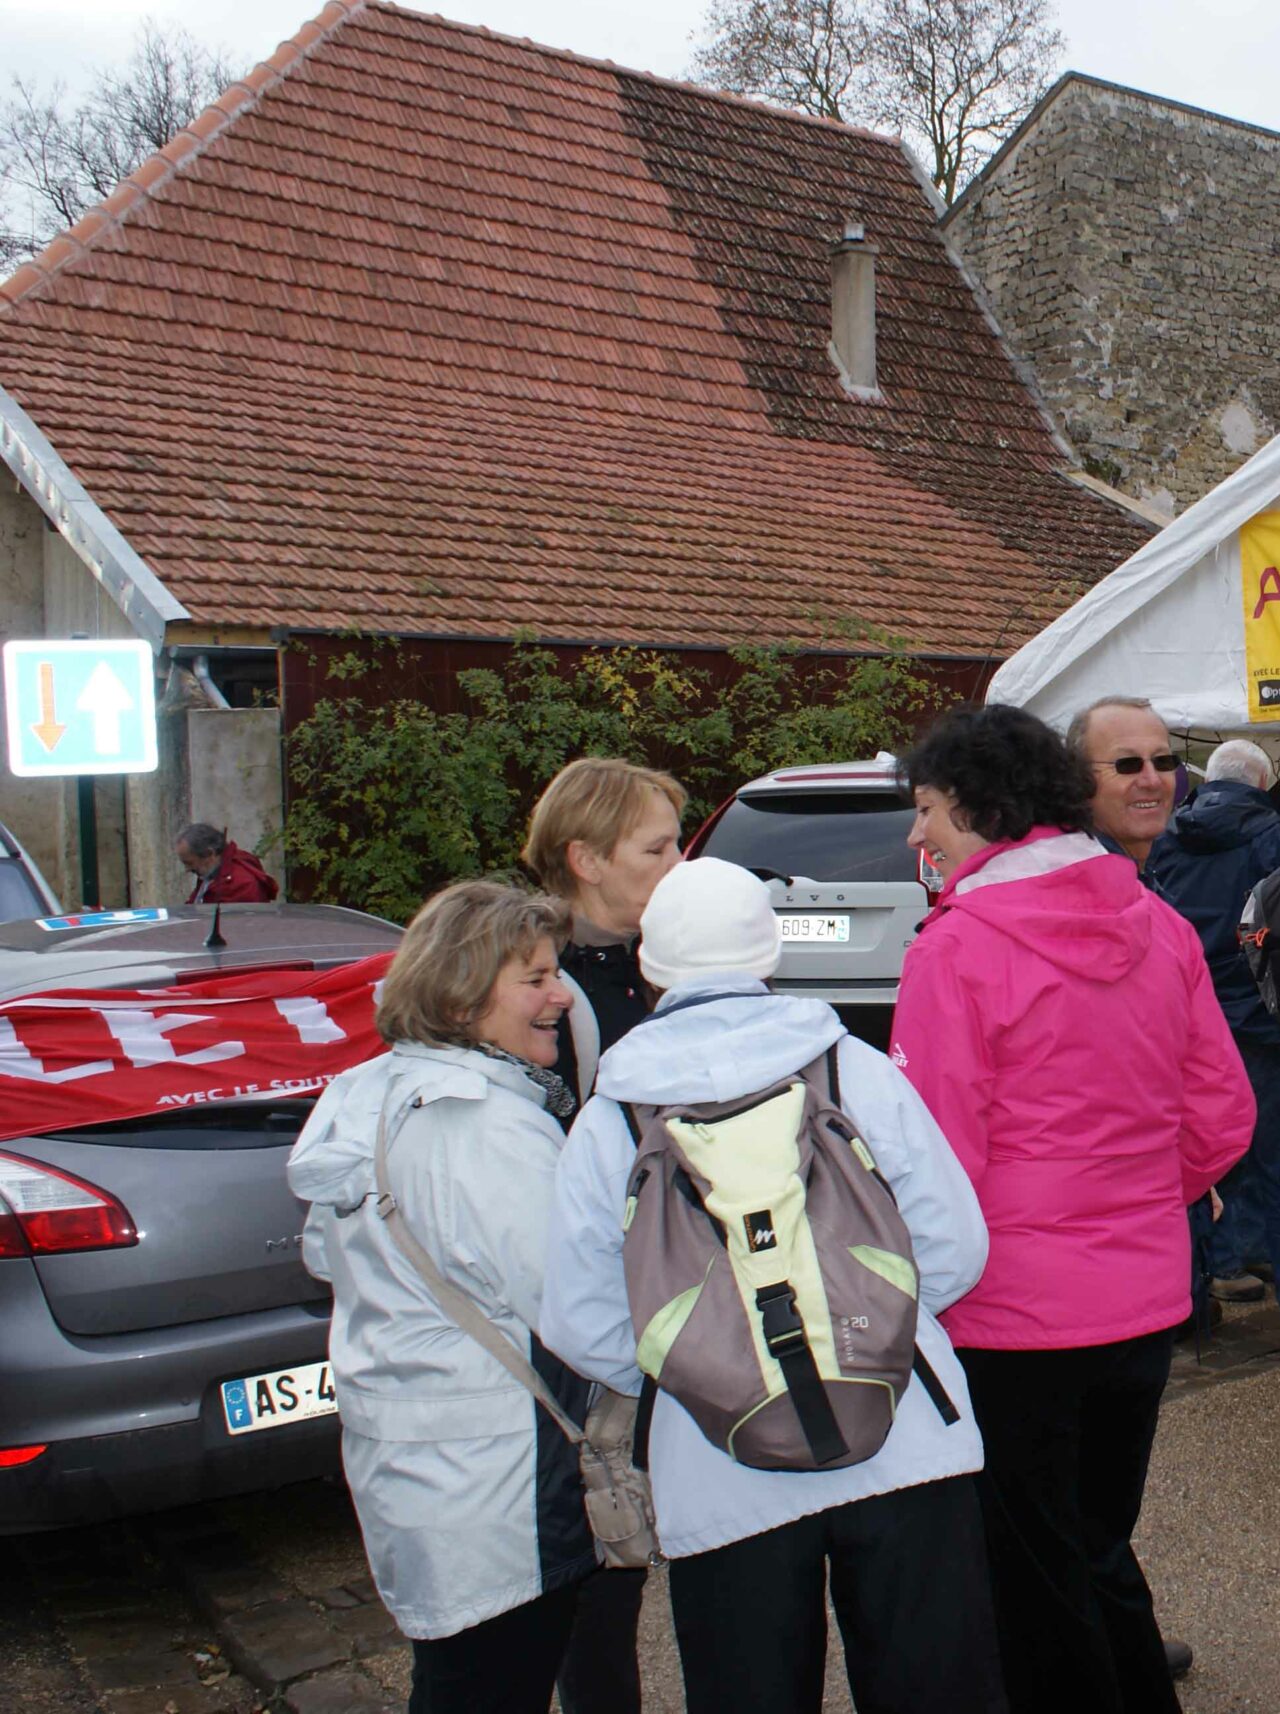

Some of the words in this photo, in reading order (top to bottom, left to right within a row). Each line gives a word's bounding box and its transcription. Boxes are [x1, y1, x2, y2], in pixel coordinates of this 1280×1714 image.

[1270, 668, 1280, 676] LE
[156, 1088, 225, 1105] AVEC
[234, 1084, 260, 1097] LE
[270, 1074, 338, 1090] SOUT
[234, 1409, 243, 1421] F
